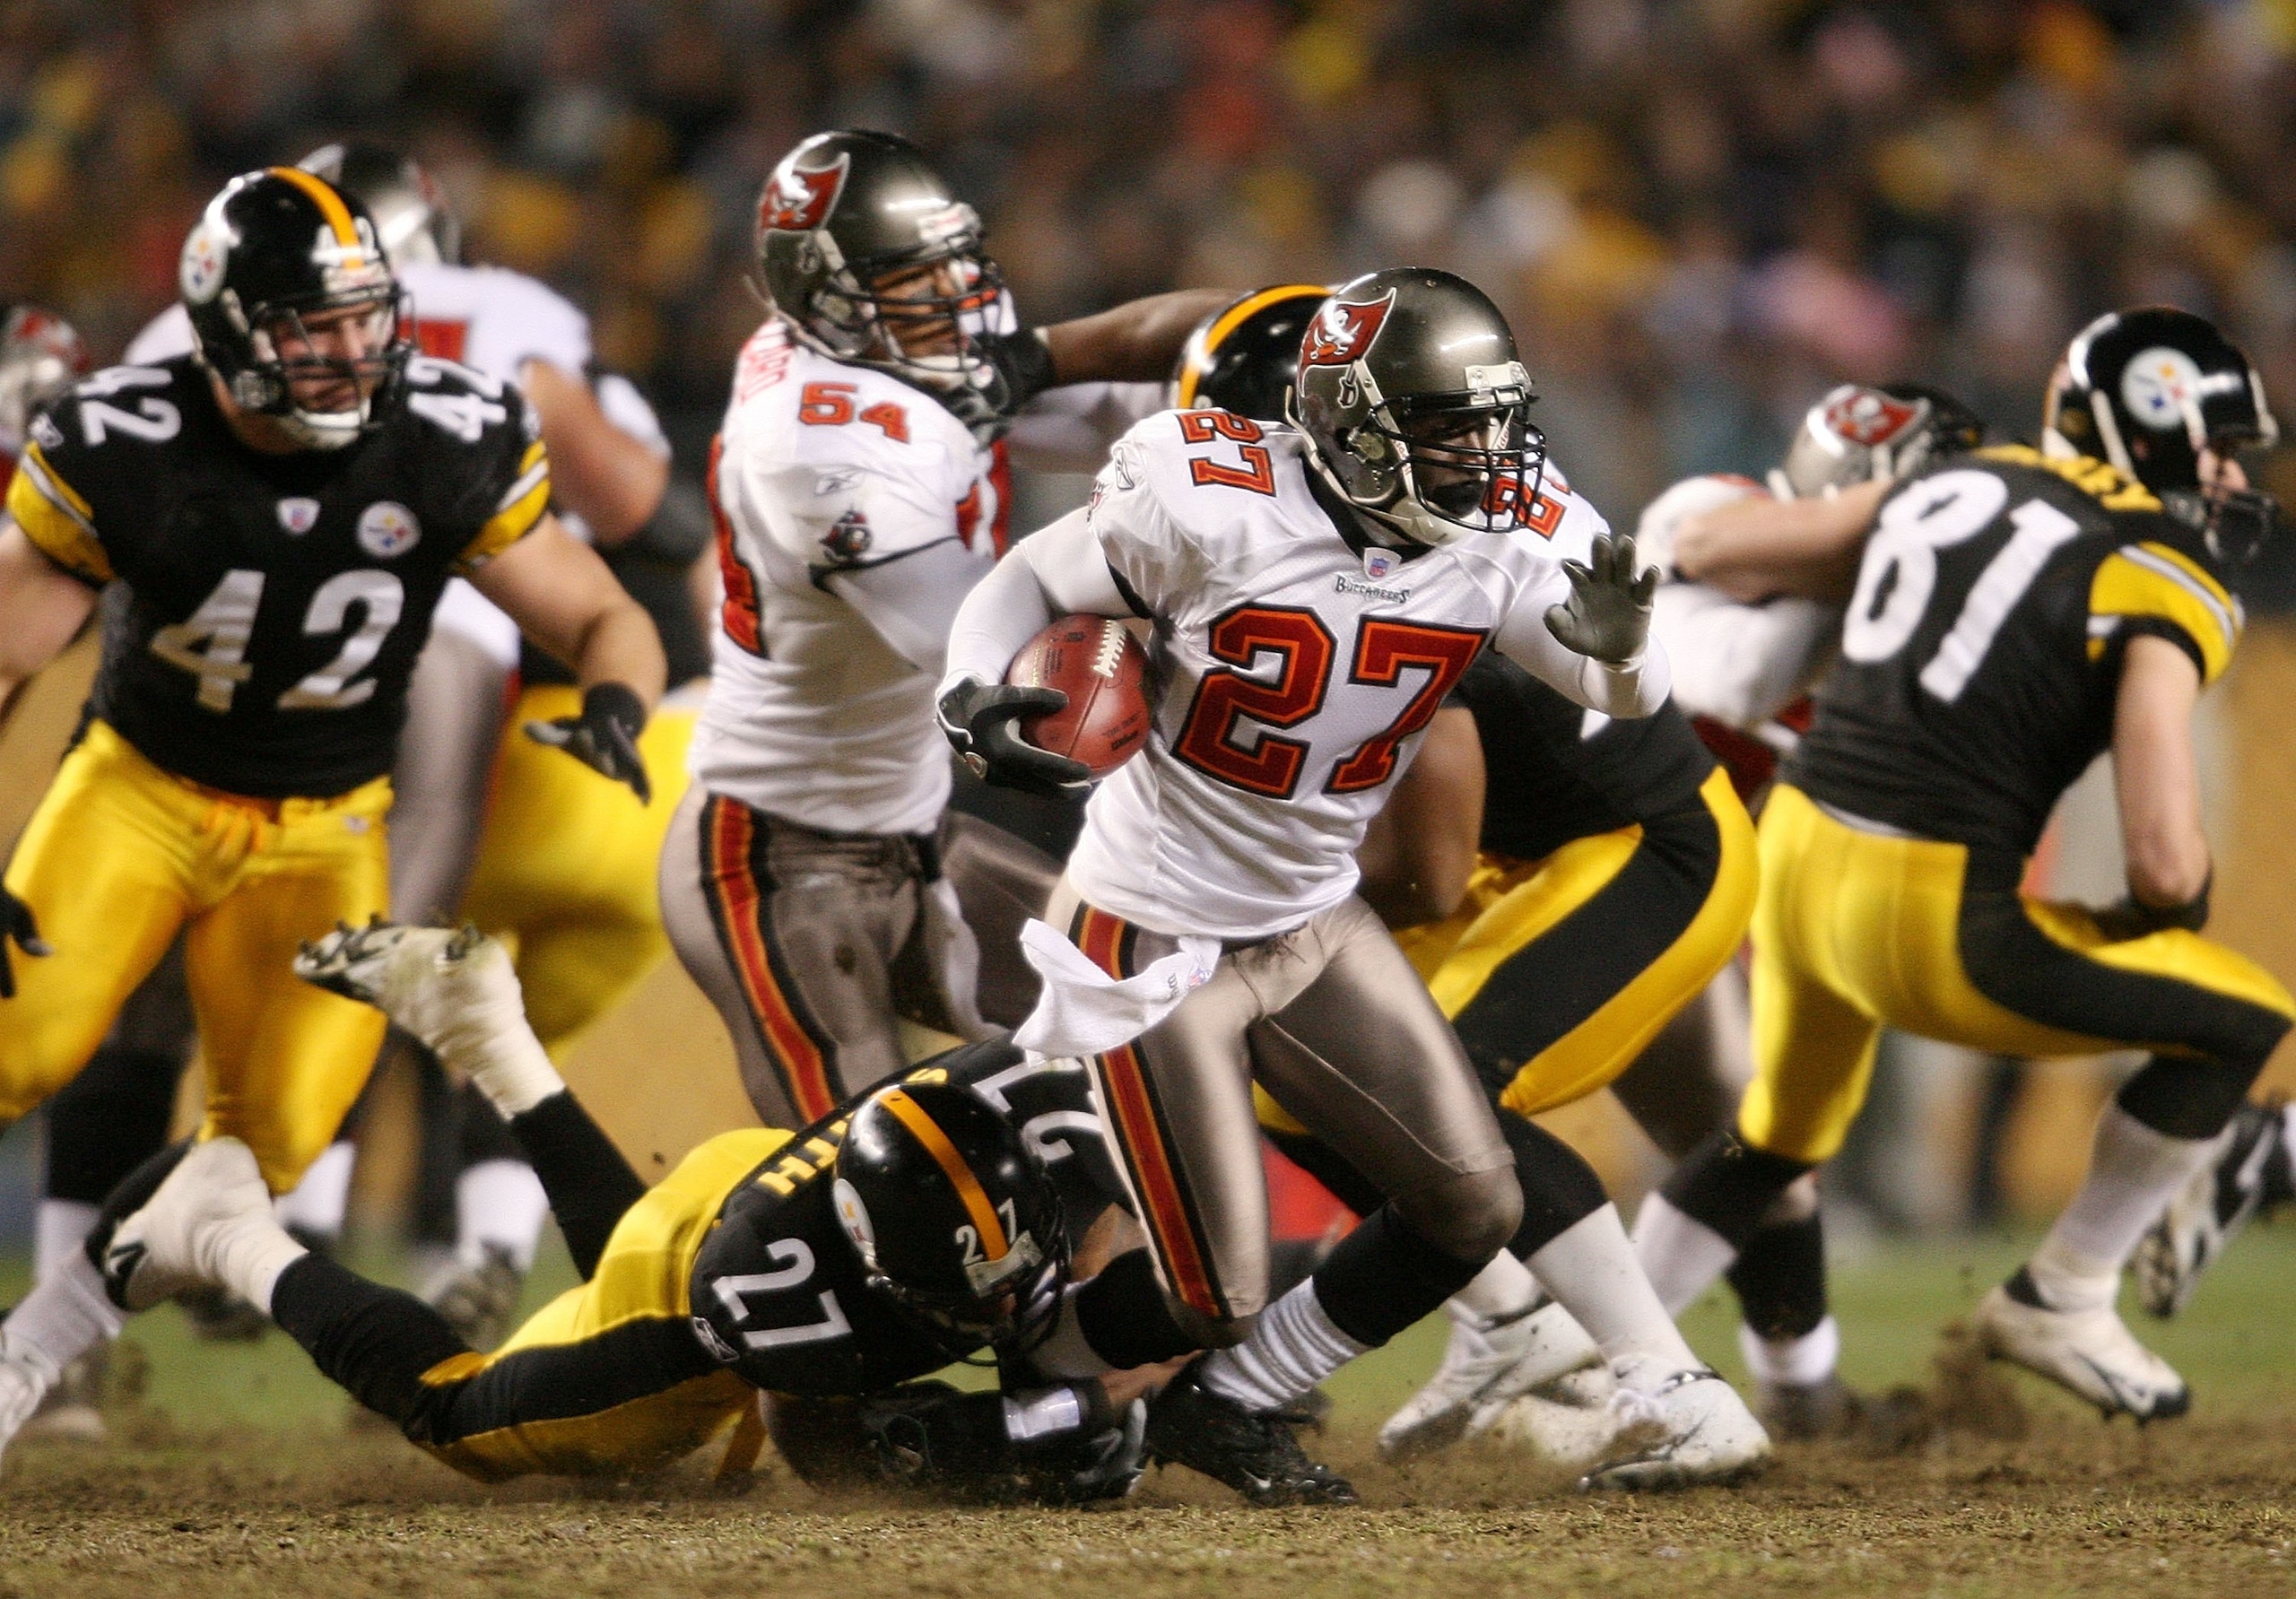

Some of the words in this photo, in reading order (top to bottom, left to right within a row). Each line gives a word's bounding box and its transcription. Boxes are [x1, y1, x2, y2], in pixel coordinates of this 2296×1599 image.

[798, 380, 910, 444] 54
[1175, 409, 1278, 498] 27
[150, 569, 404, 712] 42
[1842, 469, 2083, 705] 81
[1170, 601, 1494, 800] 27
[955, 1197, 1017, 1265] 27
[712, 1237, 853, 1346] 27
